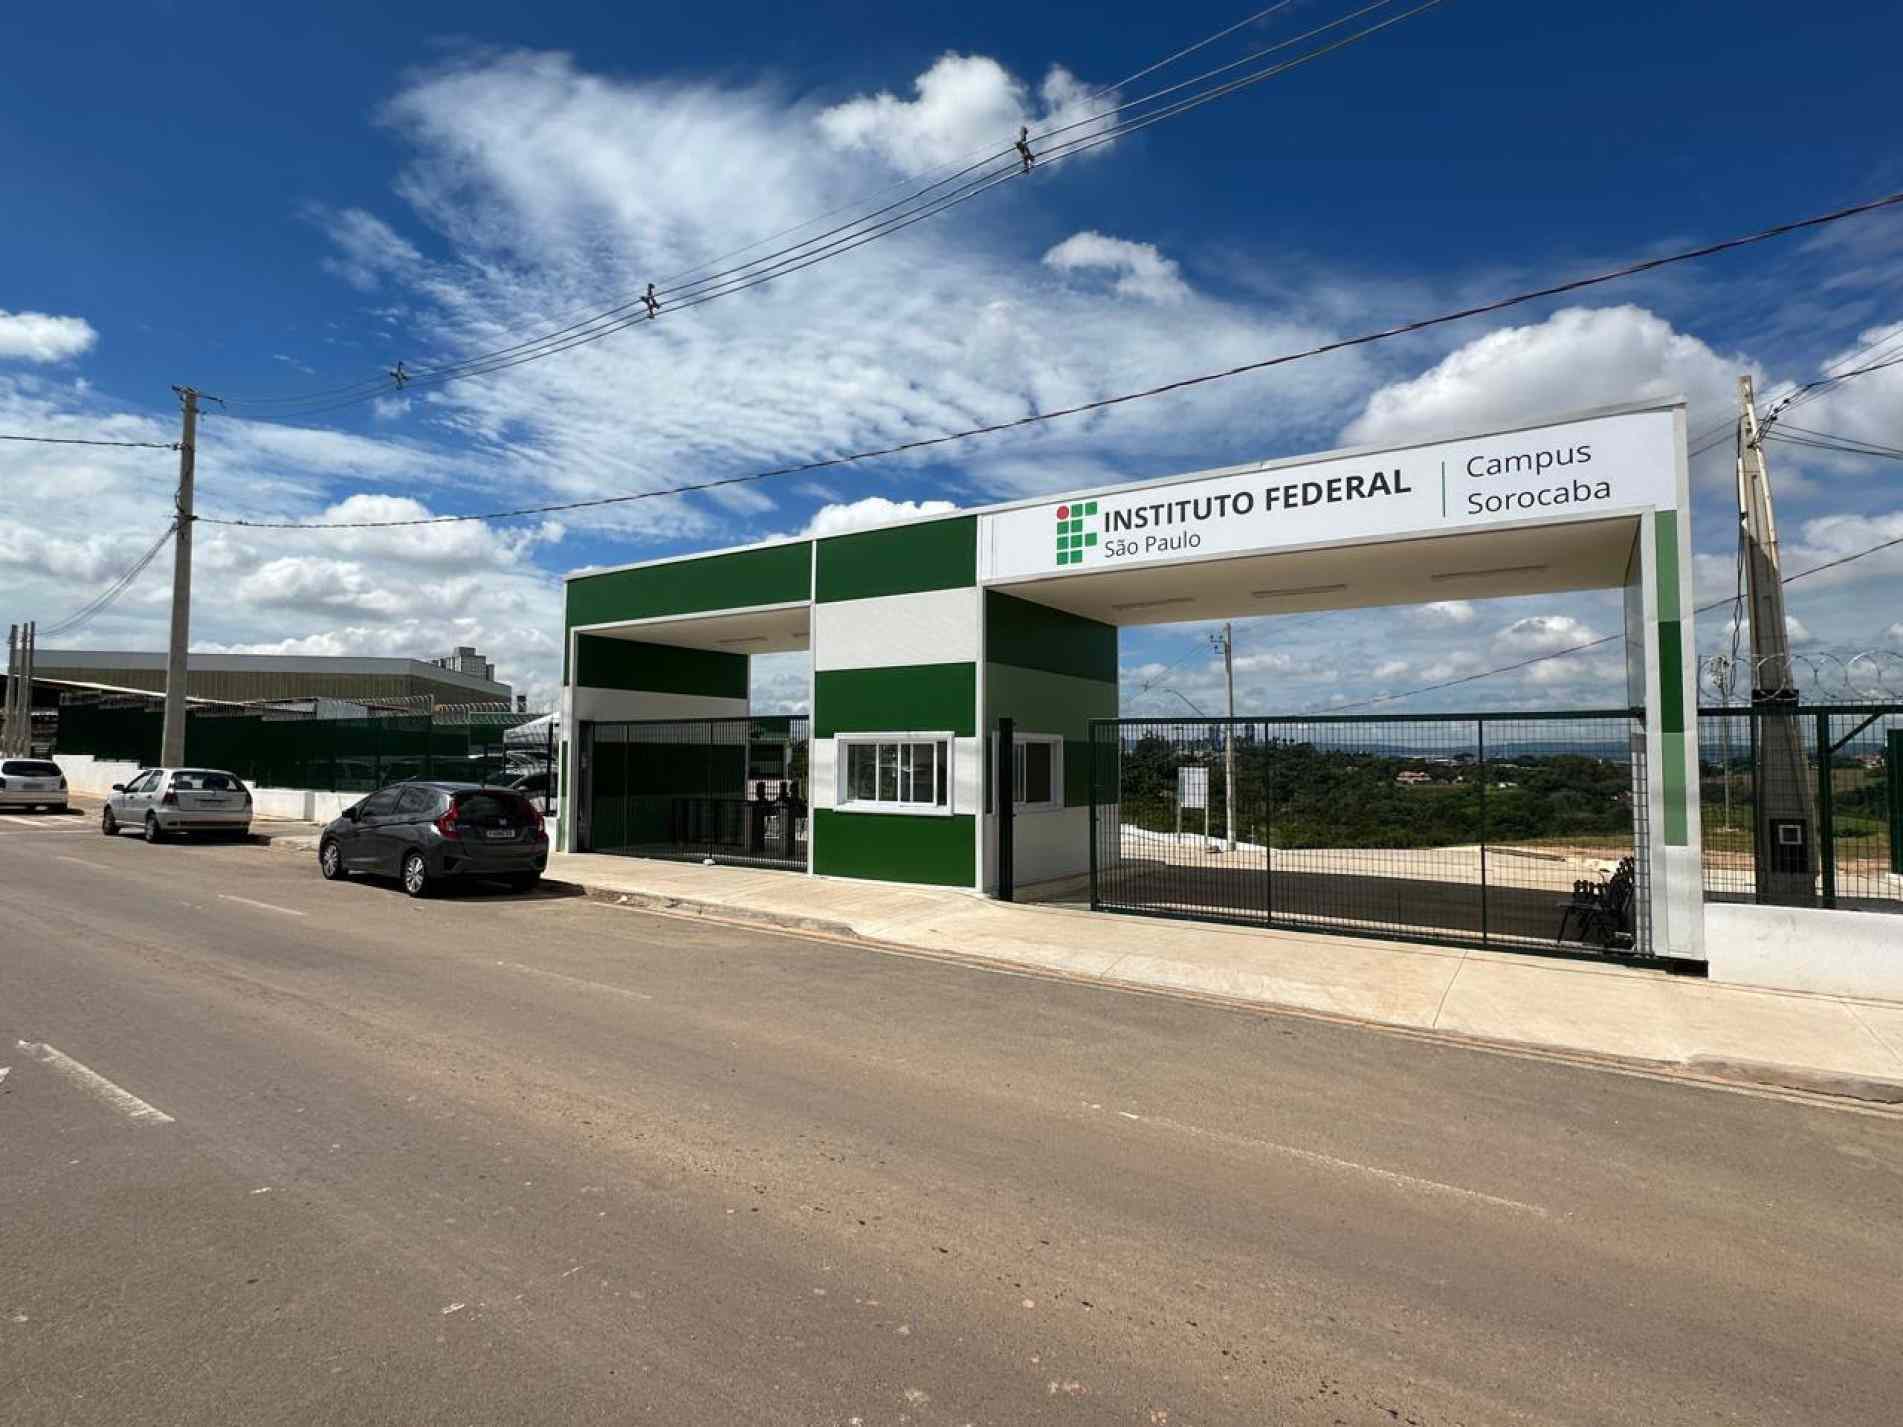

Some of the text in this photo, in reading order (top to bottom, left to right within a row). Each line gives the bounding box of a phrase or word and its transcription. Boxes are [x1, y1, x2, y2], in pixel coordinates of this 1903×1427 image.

[1466, 445, 1592, 478] Campus
[1104, 469, 1412, 534] INSTITUTO FEDERAL
[1467, 479, 1612, 516] Sorocaba
[1104, 530, 1201, 558] São Paulo
